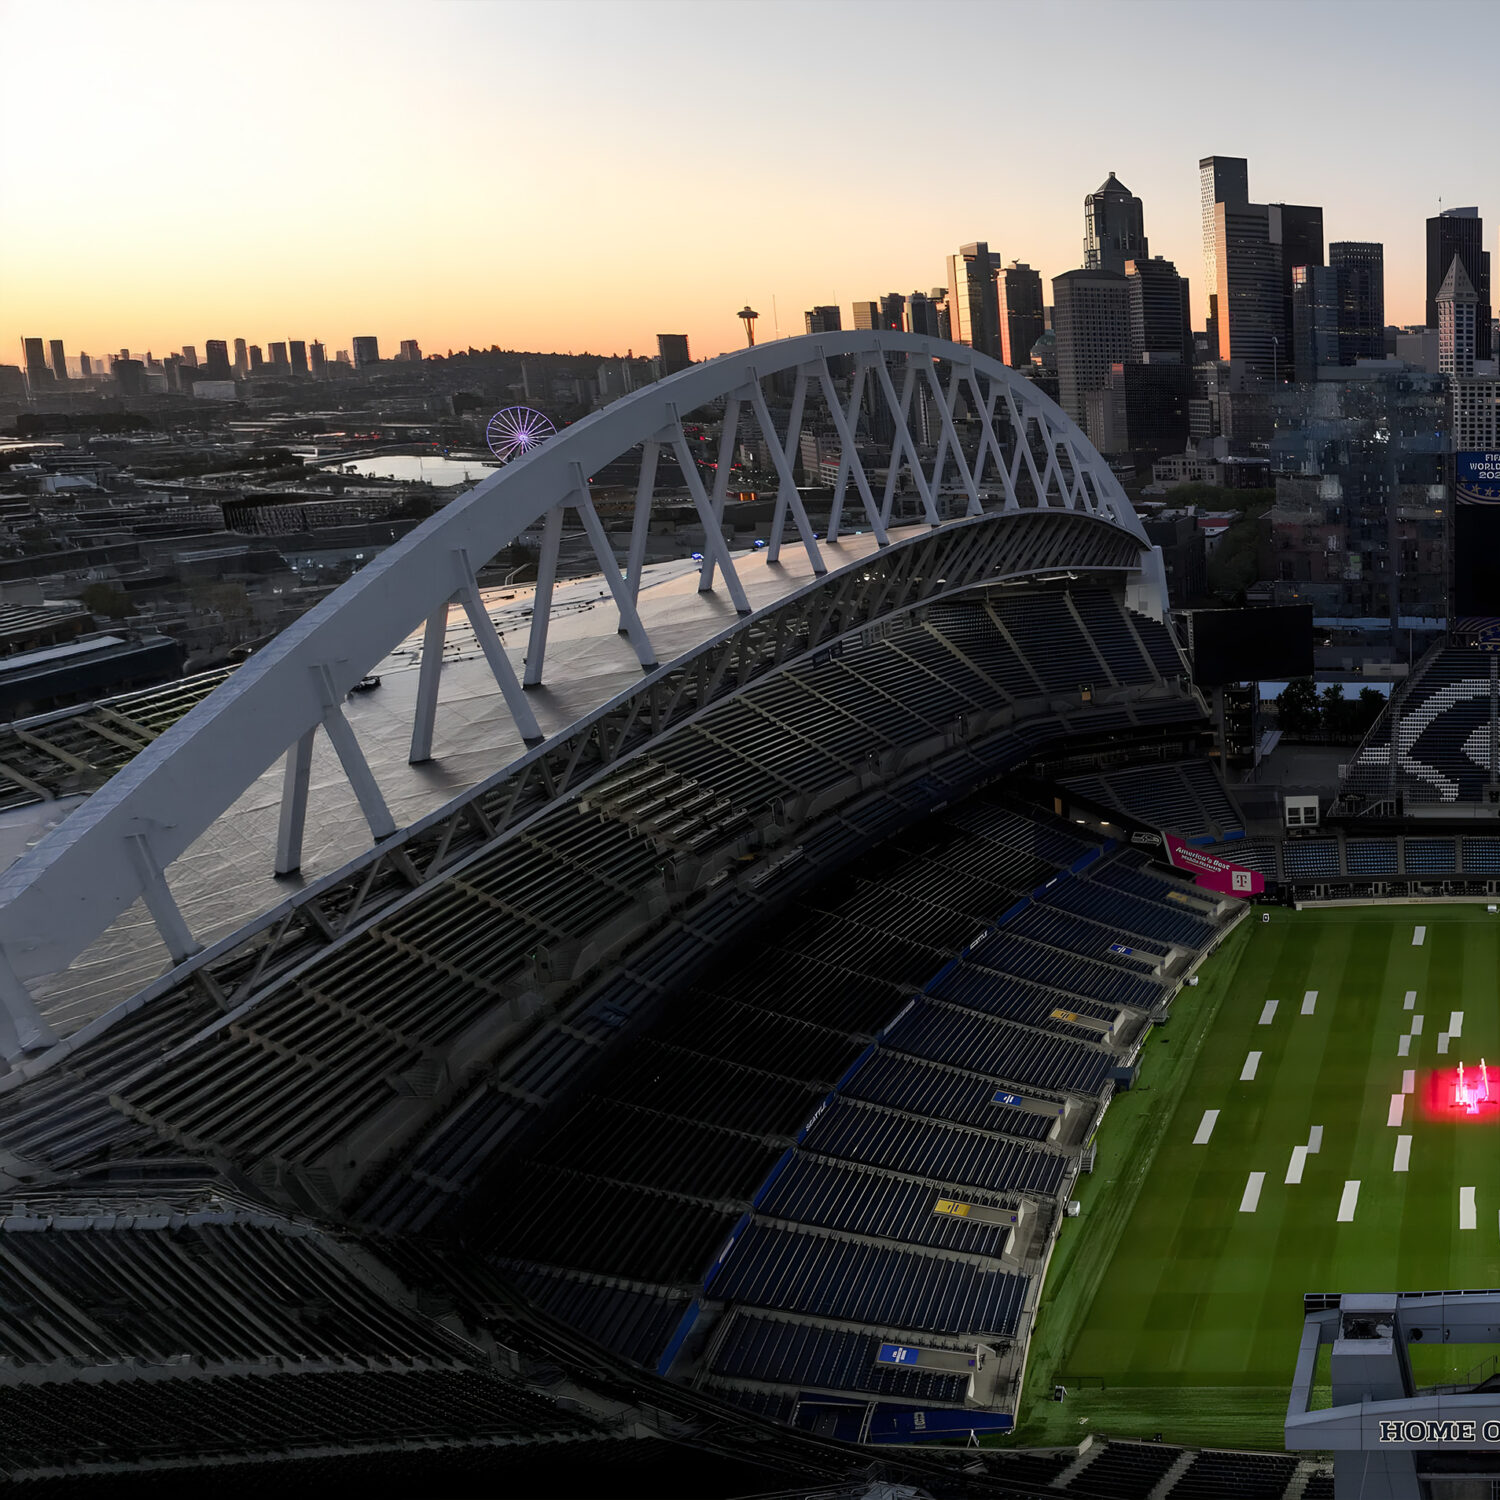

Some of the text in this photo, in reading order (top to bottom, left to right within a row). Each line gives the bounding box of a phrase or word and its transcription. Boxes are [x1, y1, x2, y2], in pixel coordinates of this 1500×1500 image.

[1469, 462, 1500, 471] WORLD
[1175, 846, 1213, 863] America's
[1379, 1420, 1476, 1442] HOME
